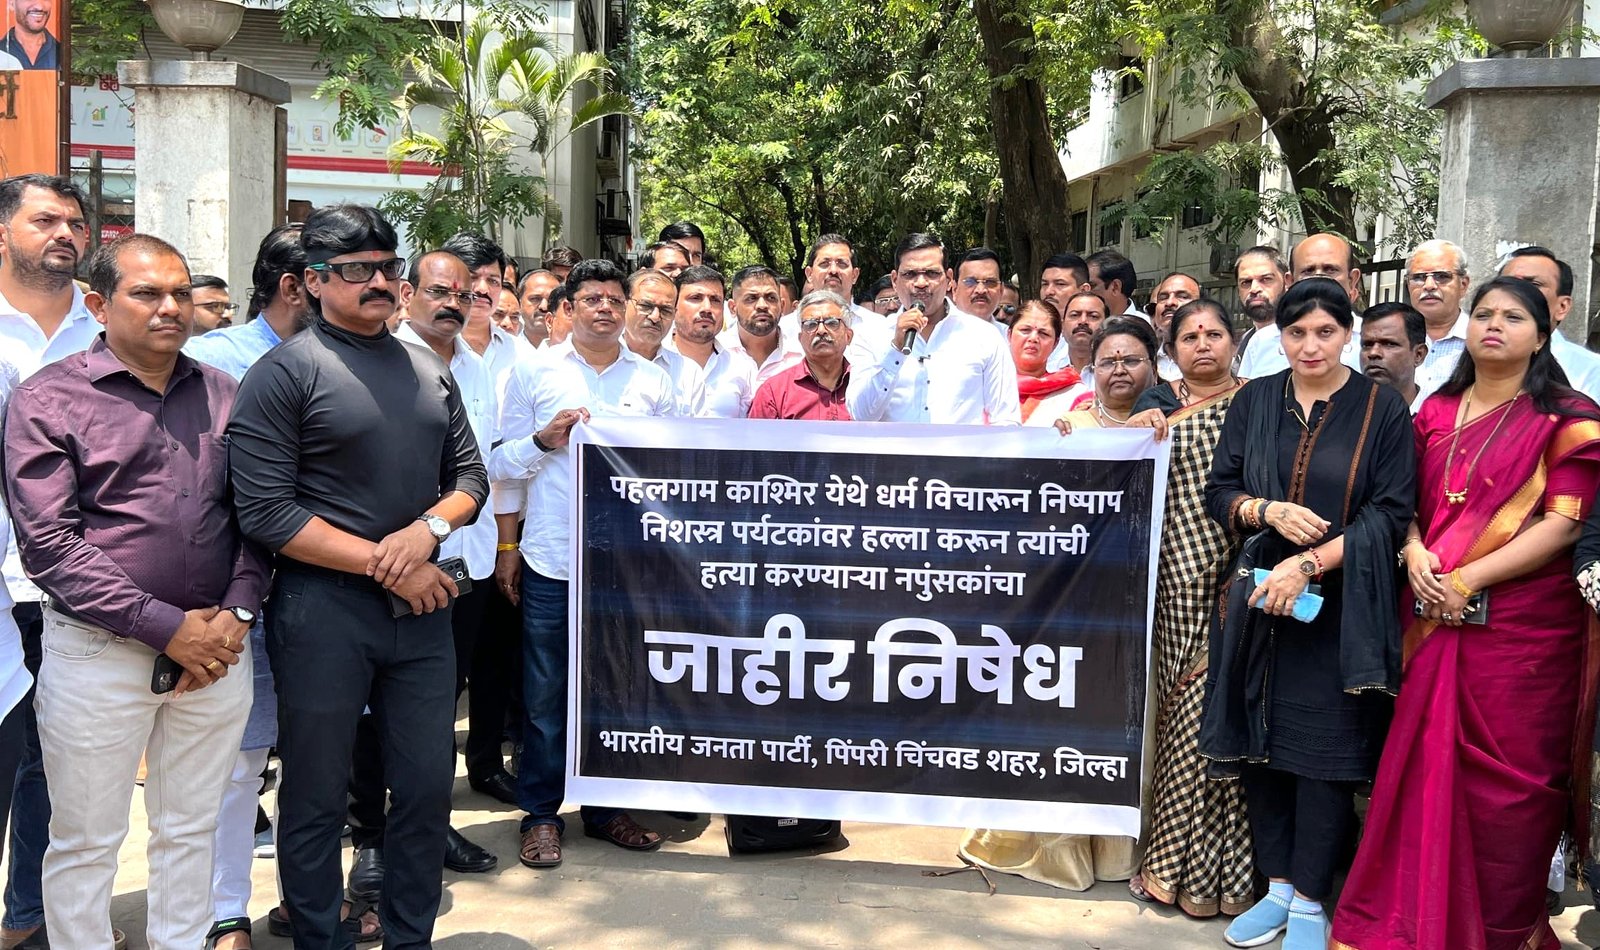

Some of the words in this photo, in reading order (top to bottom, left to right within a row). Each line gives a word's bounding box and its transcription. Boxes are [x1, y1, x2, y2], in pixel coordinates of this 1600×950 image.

[609, 476, 719, 504] पहलगाम
[725, 473, 819, 506] काश्मिर
[824, 474, 869, 507] येथे
[875, 476, 919, 509] धर्म
[924, 478, 1032, 513] विचारून
[1038, 482, 1125, 515] निष्पाप
[639, 511, 726, 544] निशस्त्र
[731, 513, 856, 549] पर्यटकांवर
[860, 524, 930, 553] हल्ला
[936, 528, 1010, 554] करून
[1016, 523, 1091, 556] त्यांची
[700, 561, 758, 590] हत्या
[763, 563, 889, 591] करण्याऱ्या
[894, 561, 1027, 602] नपुंसकांचा
[644, 613, 856, 706] जाहीर
[866, 617, 1083, 709] निषेध
[599, 725, 685, 756] भारतीय
[690, 735, 756, 760] जनता
[761, 734, 818, 769] पार्टी,
[824, 737, 889, 767] पिंपरी
[894, 739, 981, 770] चिंचवड
[985, 749, 1047, 780] शहर,
[1052, 746, 1129, 782] जिल्हा
